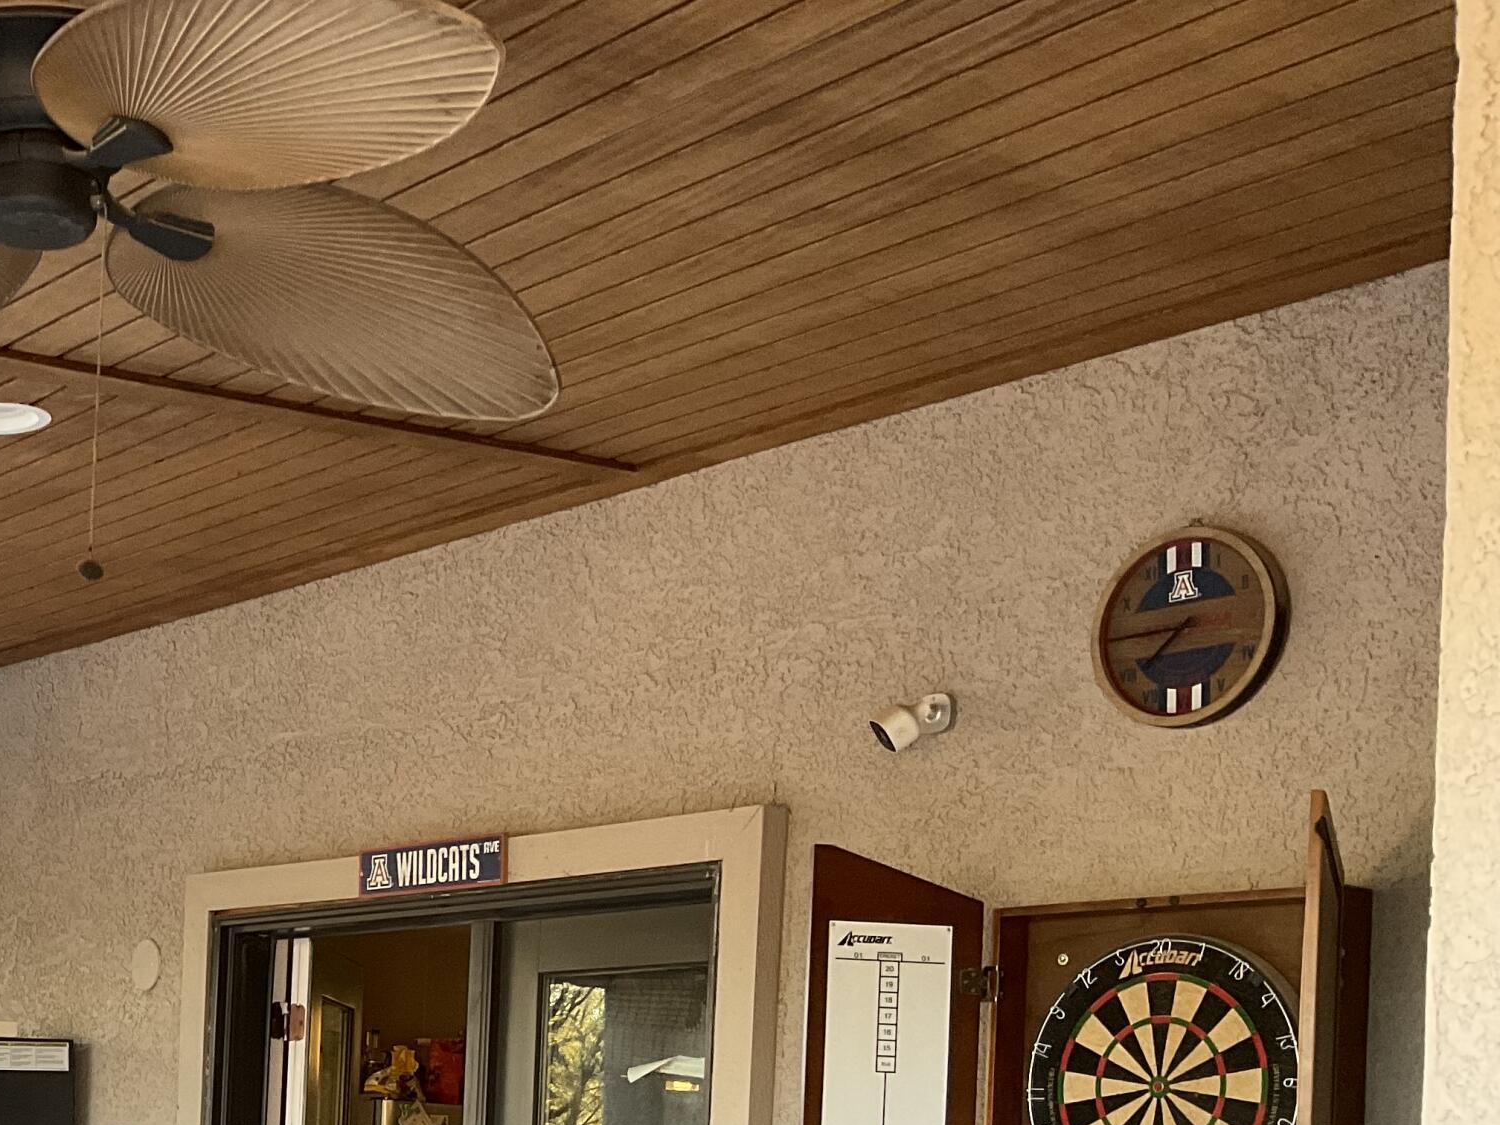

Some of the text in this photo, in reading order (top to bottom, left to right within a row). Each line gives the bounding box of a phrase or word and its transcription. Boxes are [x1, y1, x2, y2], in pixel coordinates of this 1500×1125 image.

[1169, 570, 1198, 603] A
[396, 843, 480, 887] WILDCATS
[483, 841, 500, 854] AVE
